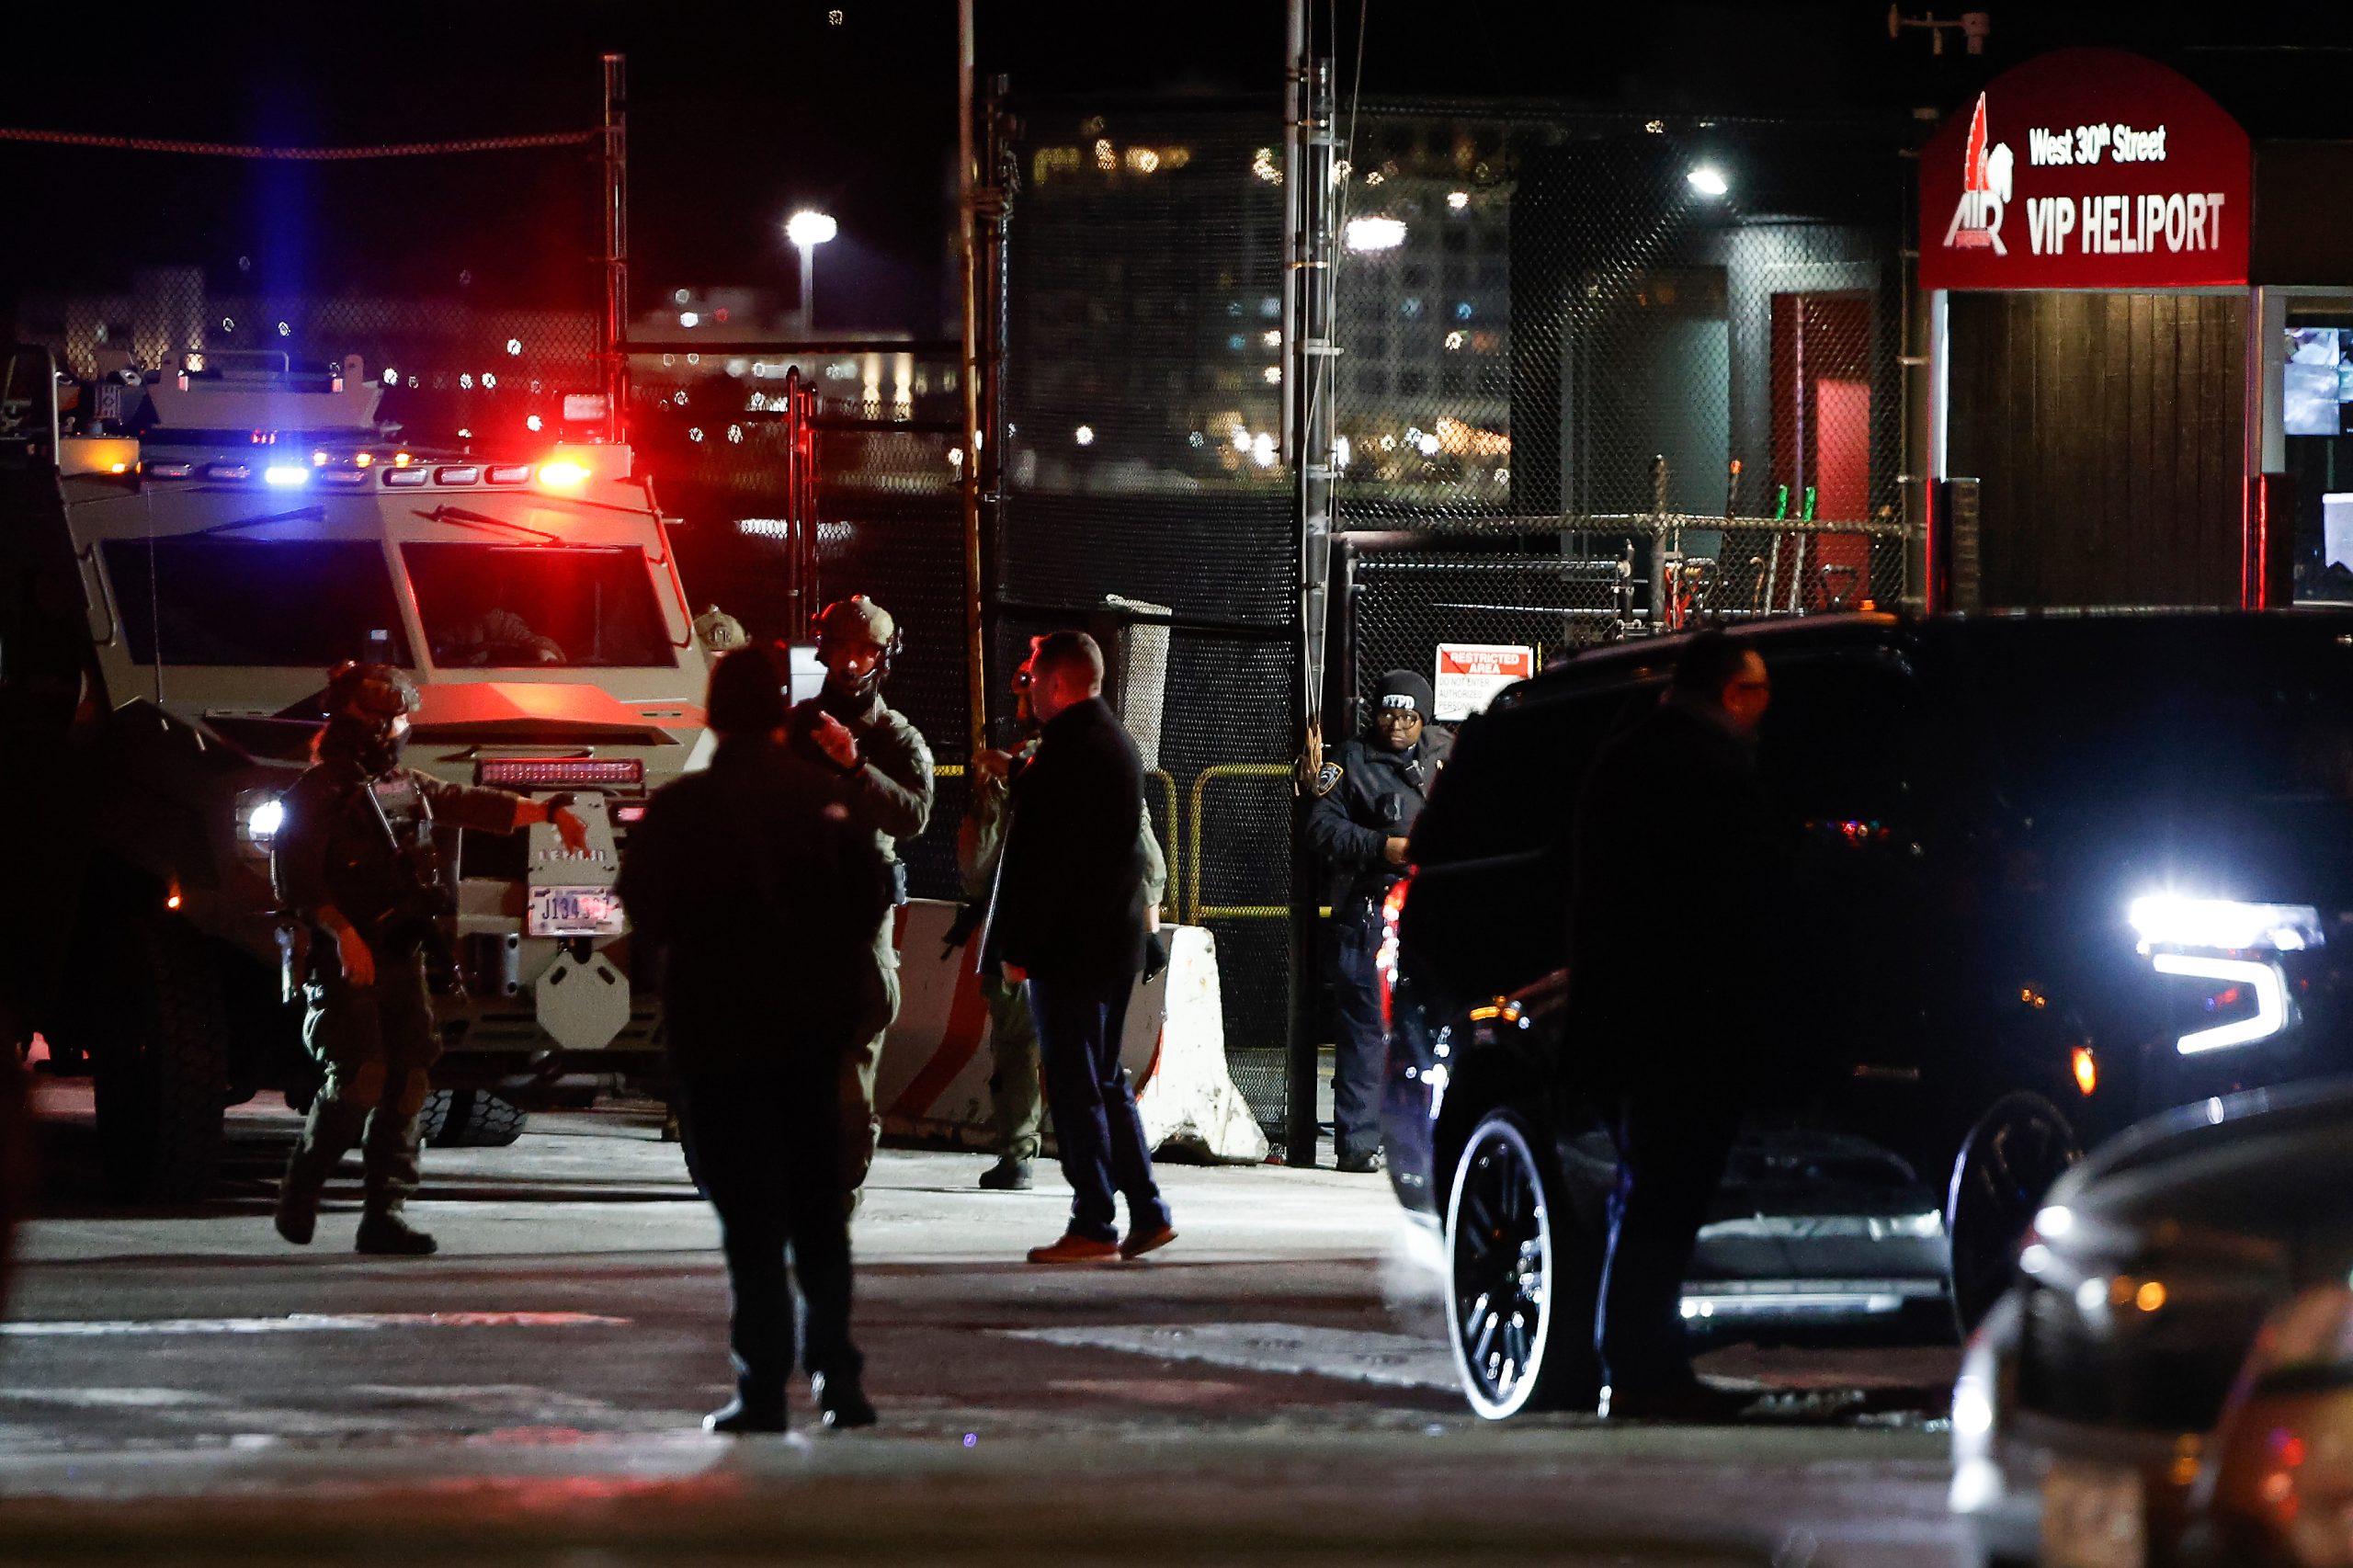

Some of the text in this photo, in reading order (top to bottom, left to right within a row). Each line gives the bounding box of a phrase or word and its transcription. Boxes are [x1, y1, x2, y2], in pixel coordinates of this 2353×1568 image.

[2029, 127, 2074, 165] West
[2112, 124, 2166, 163] Street
[2027, 192, 2225, 256] VIP HELIPORT
[1450, 652, 1519, 665] RESTRICTED
[1469, 663, 1500, 674] AREA
[1439, 676, 1490, 687] DO NOT ENTER
[1439, 688, 1483, 699] AUTHORIZED
[1382, 695, 1415, 710] NYPD
[542, 898, 610, 919] J1347
